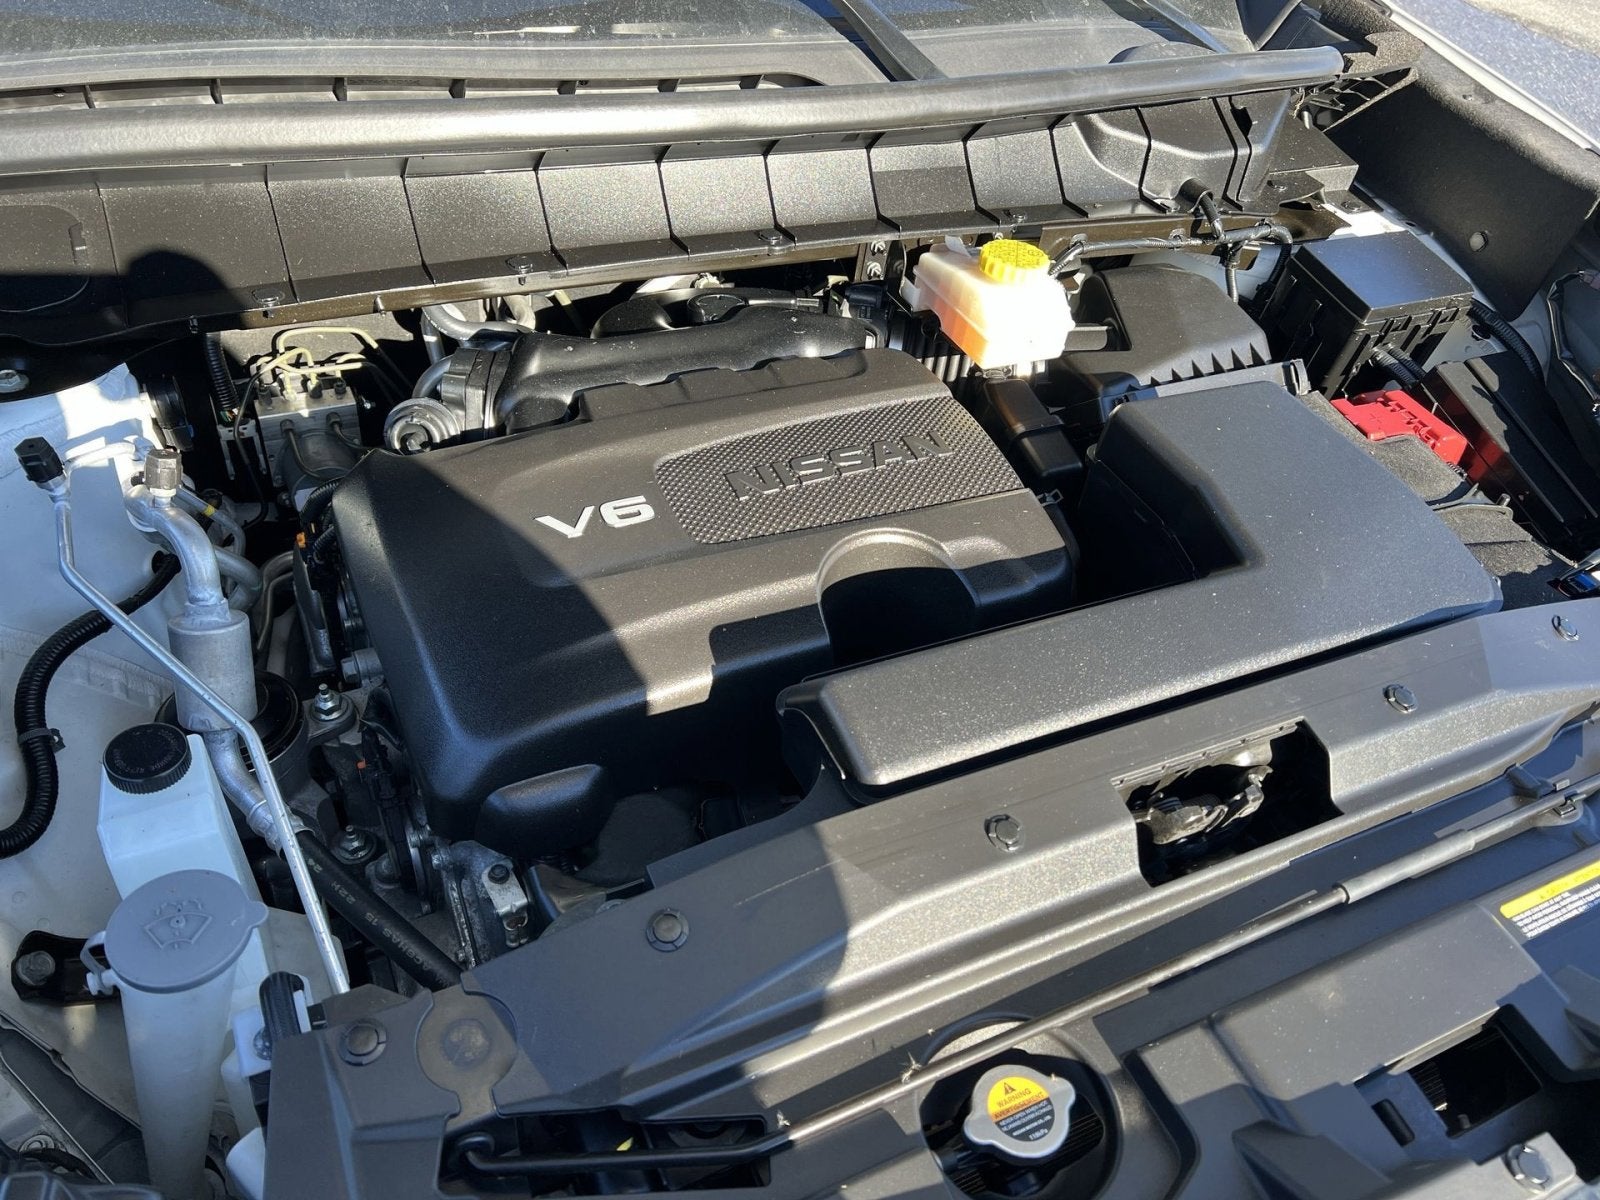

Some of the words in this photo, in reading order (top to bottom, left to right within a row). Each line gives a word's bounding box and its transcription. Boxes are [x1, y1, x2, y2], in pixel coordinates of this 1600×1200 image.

[725, 431, 954, 501] NISSAN
[535, 495, 655, 538] V6
[997, 1088, 1031, 1107] WARNING
